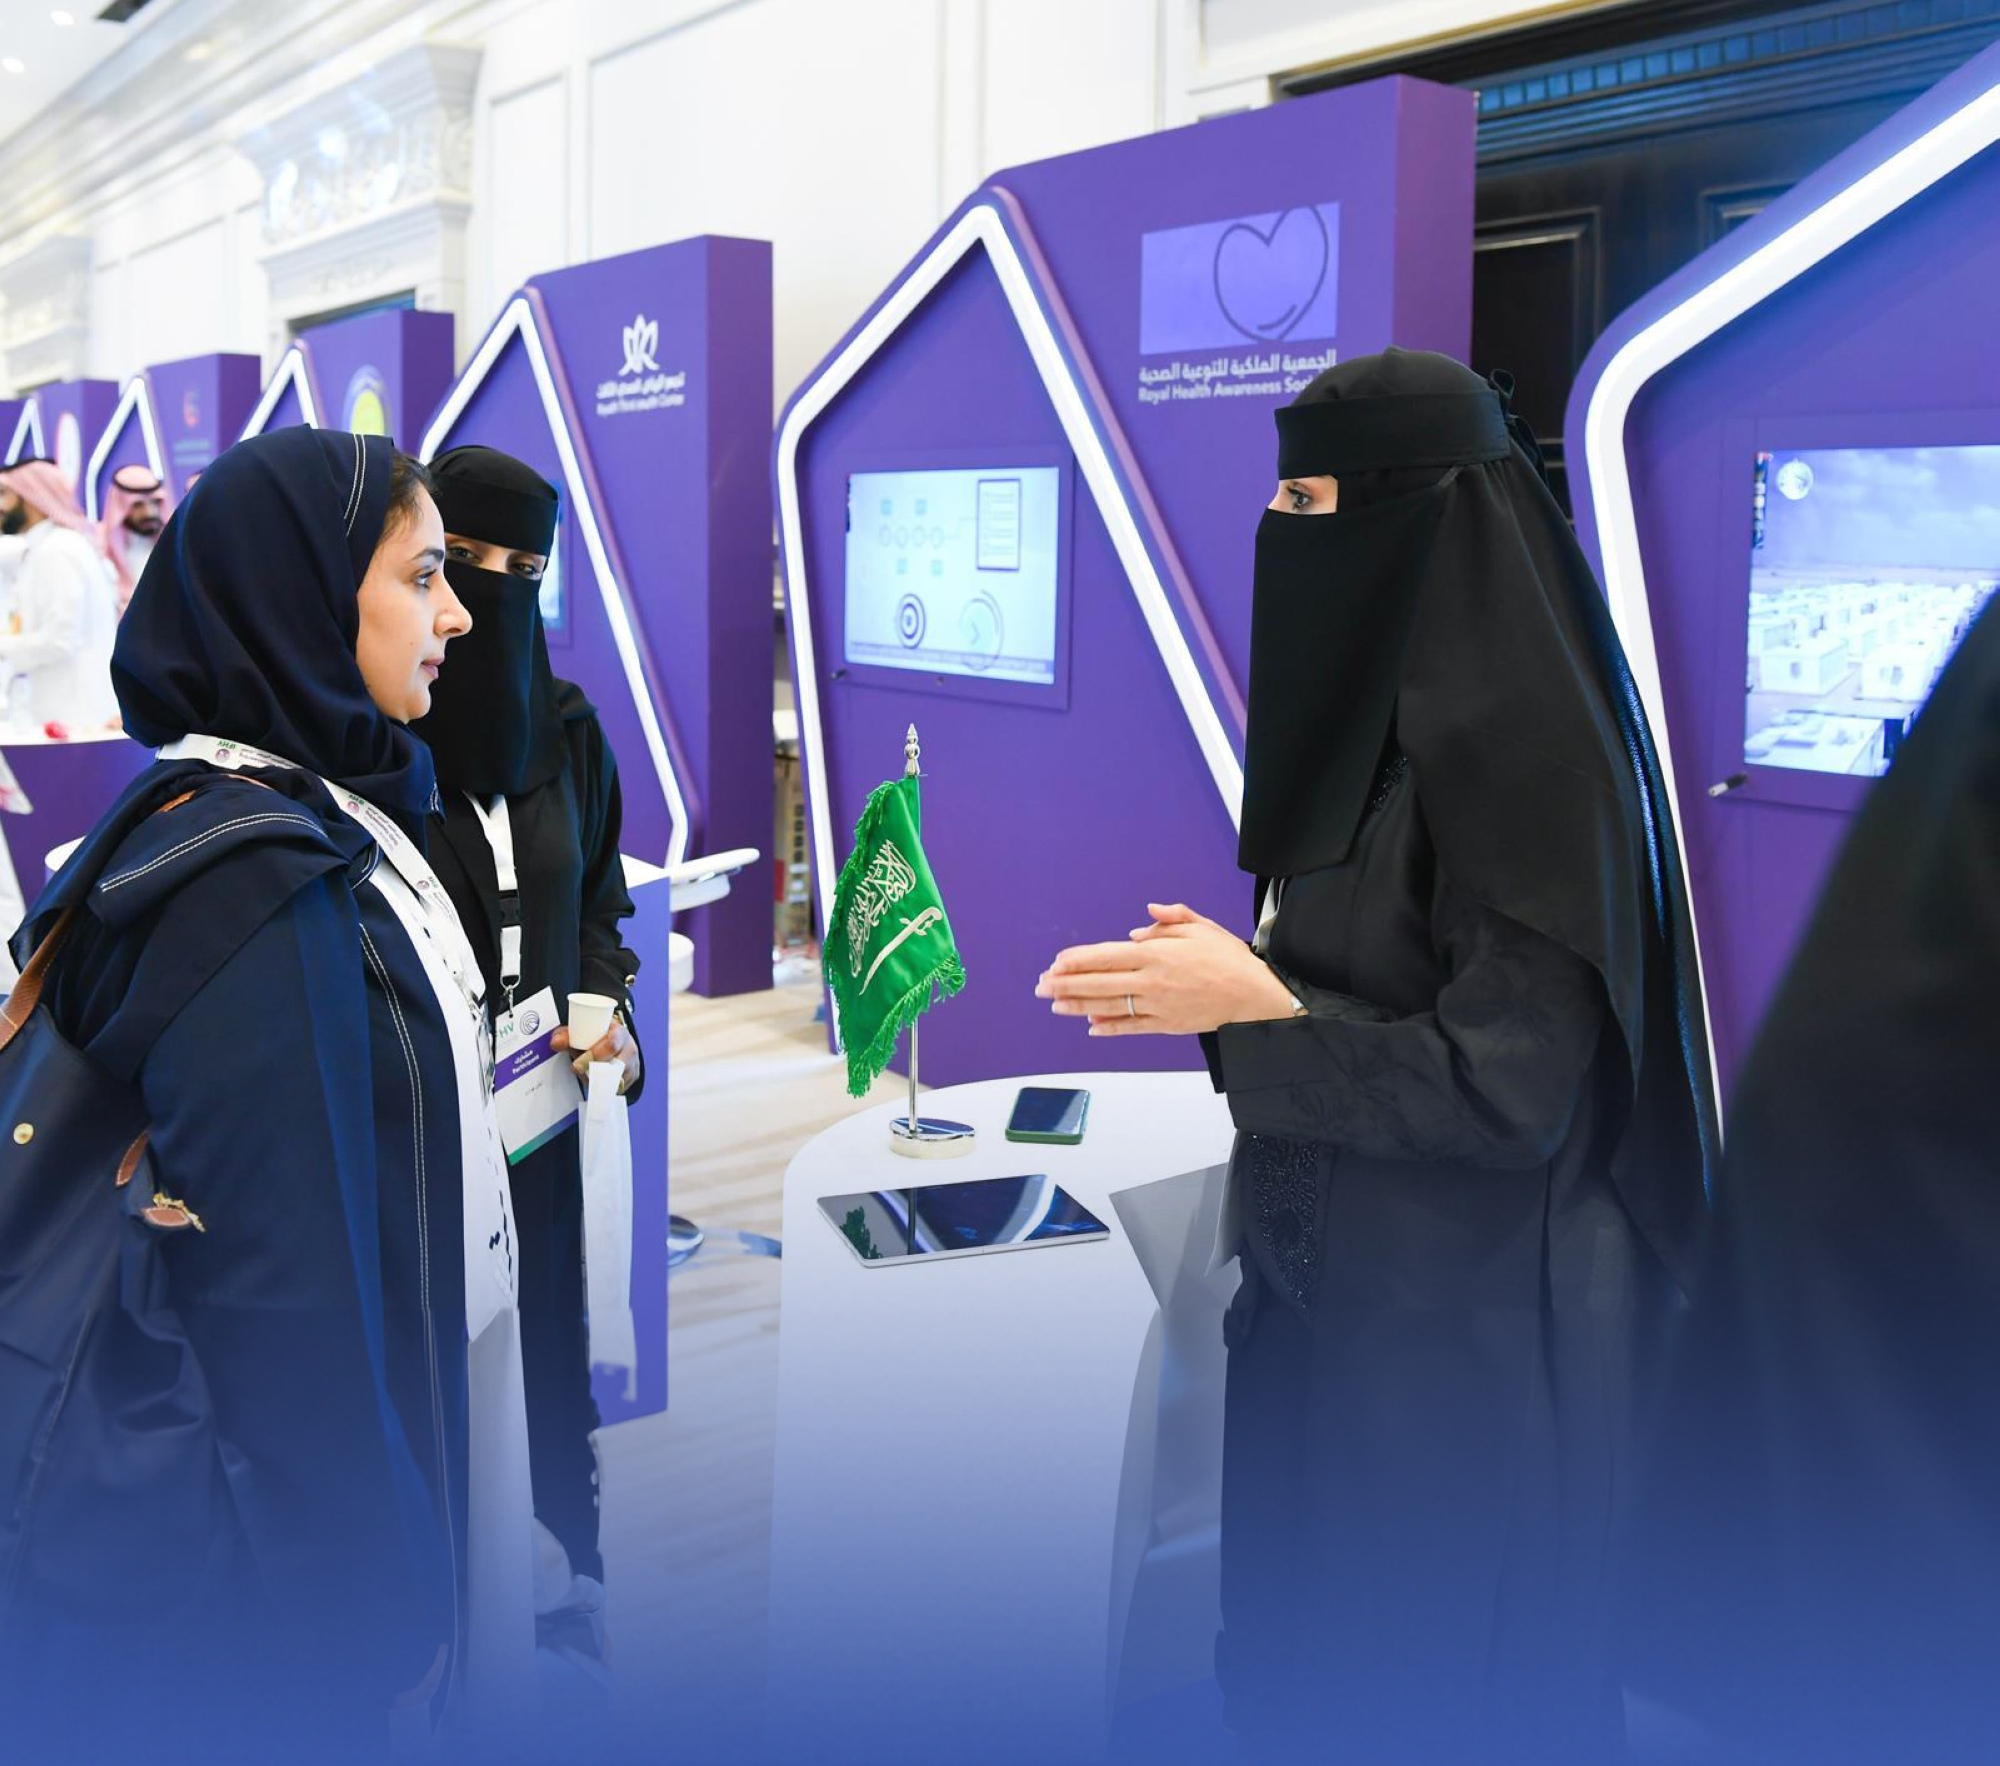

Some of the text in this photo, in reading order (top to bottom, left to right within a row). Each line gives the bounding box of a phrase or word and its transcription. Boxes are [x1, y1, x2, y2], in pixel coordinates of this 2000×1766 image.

[1139, 348, 1337, 386] الجمعية الملكية للتوعية الصحية
[1138, 384, 1171, 406] Royal
[1172, 381, 1212, 400] Health
[1213, 380, 1282, 398] Awareness
